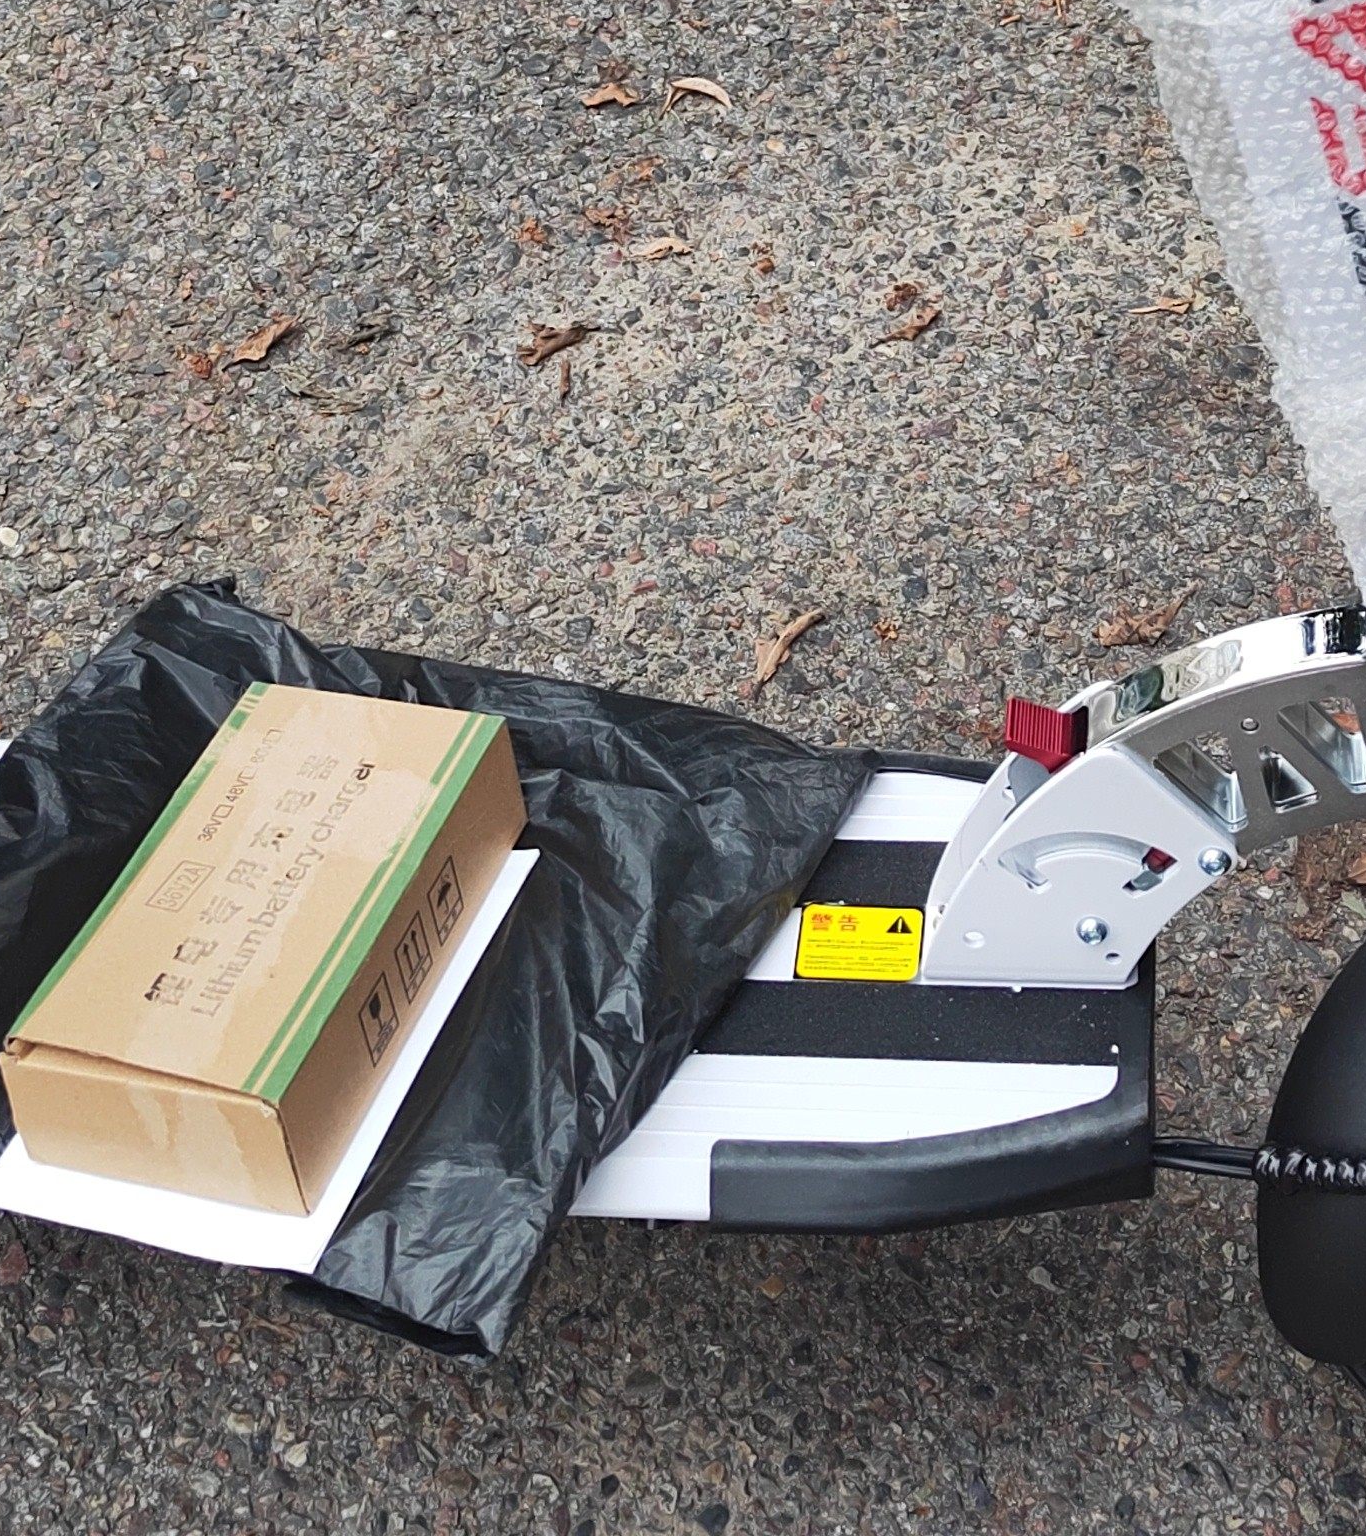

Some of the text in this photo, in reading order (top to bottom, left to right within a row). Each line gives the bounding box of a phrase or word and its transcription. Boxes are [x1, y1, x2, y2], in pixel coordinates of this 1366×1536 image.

[191, 761, 376, 1018] Lithium battery charger
